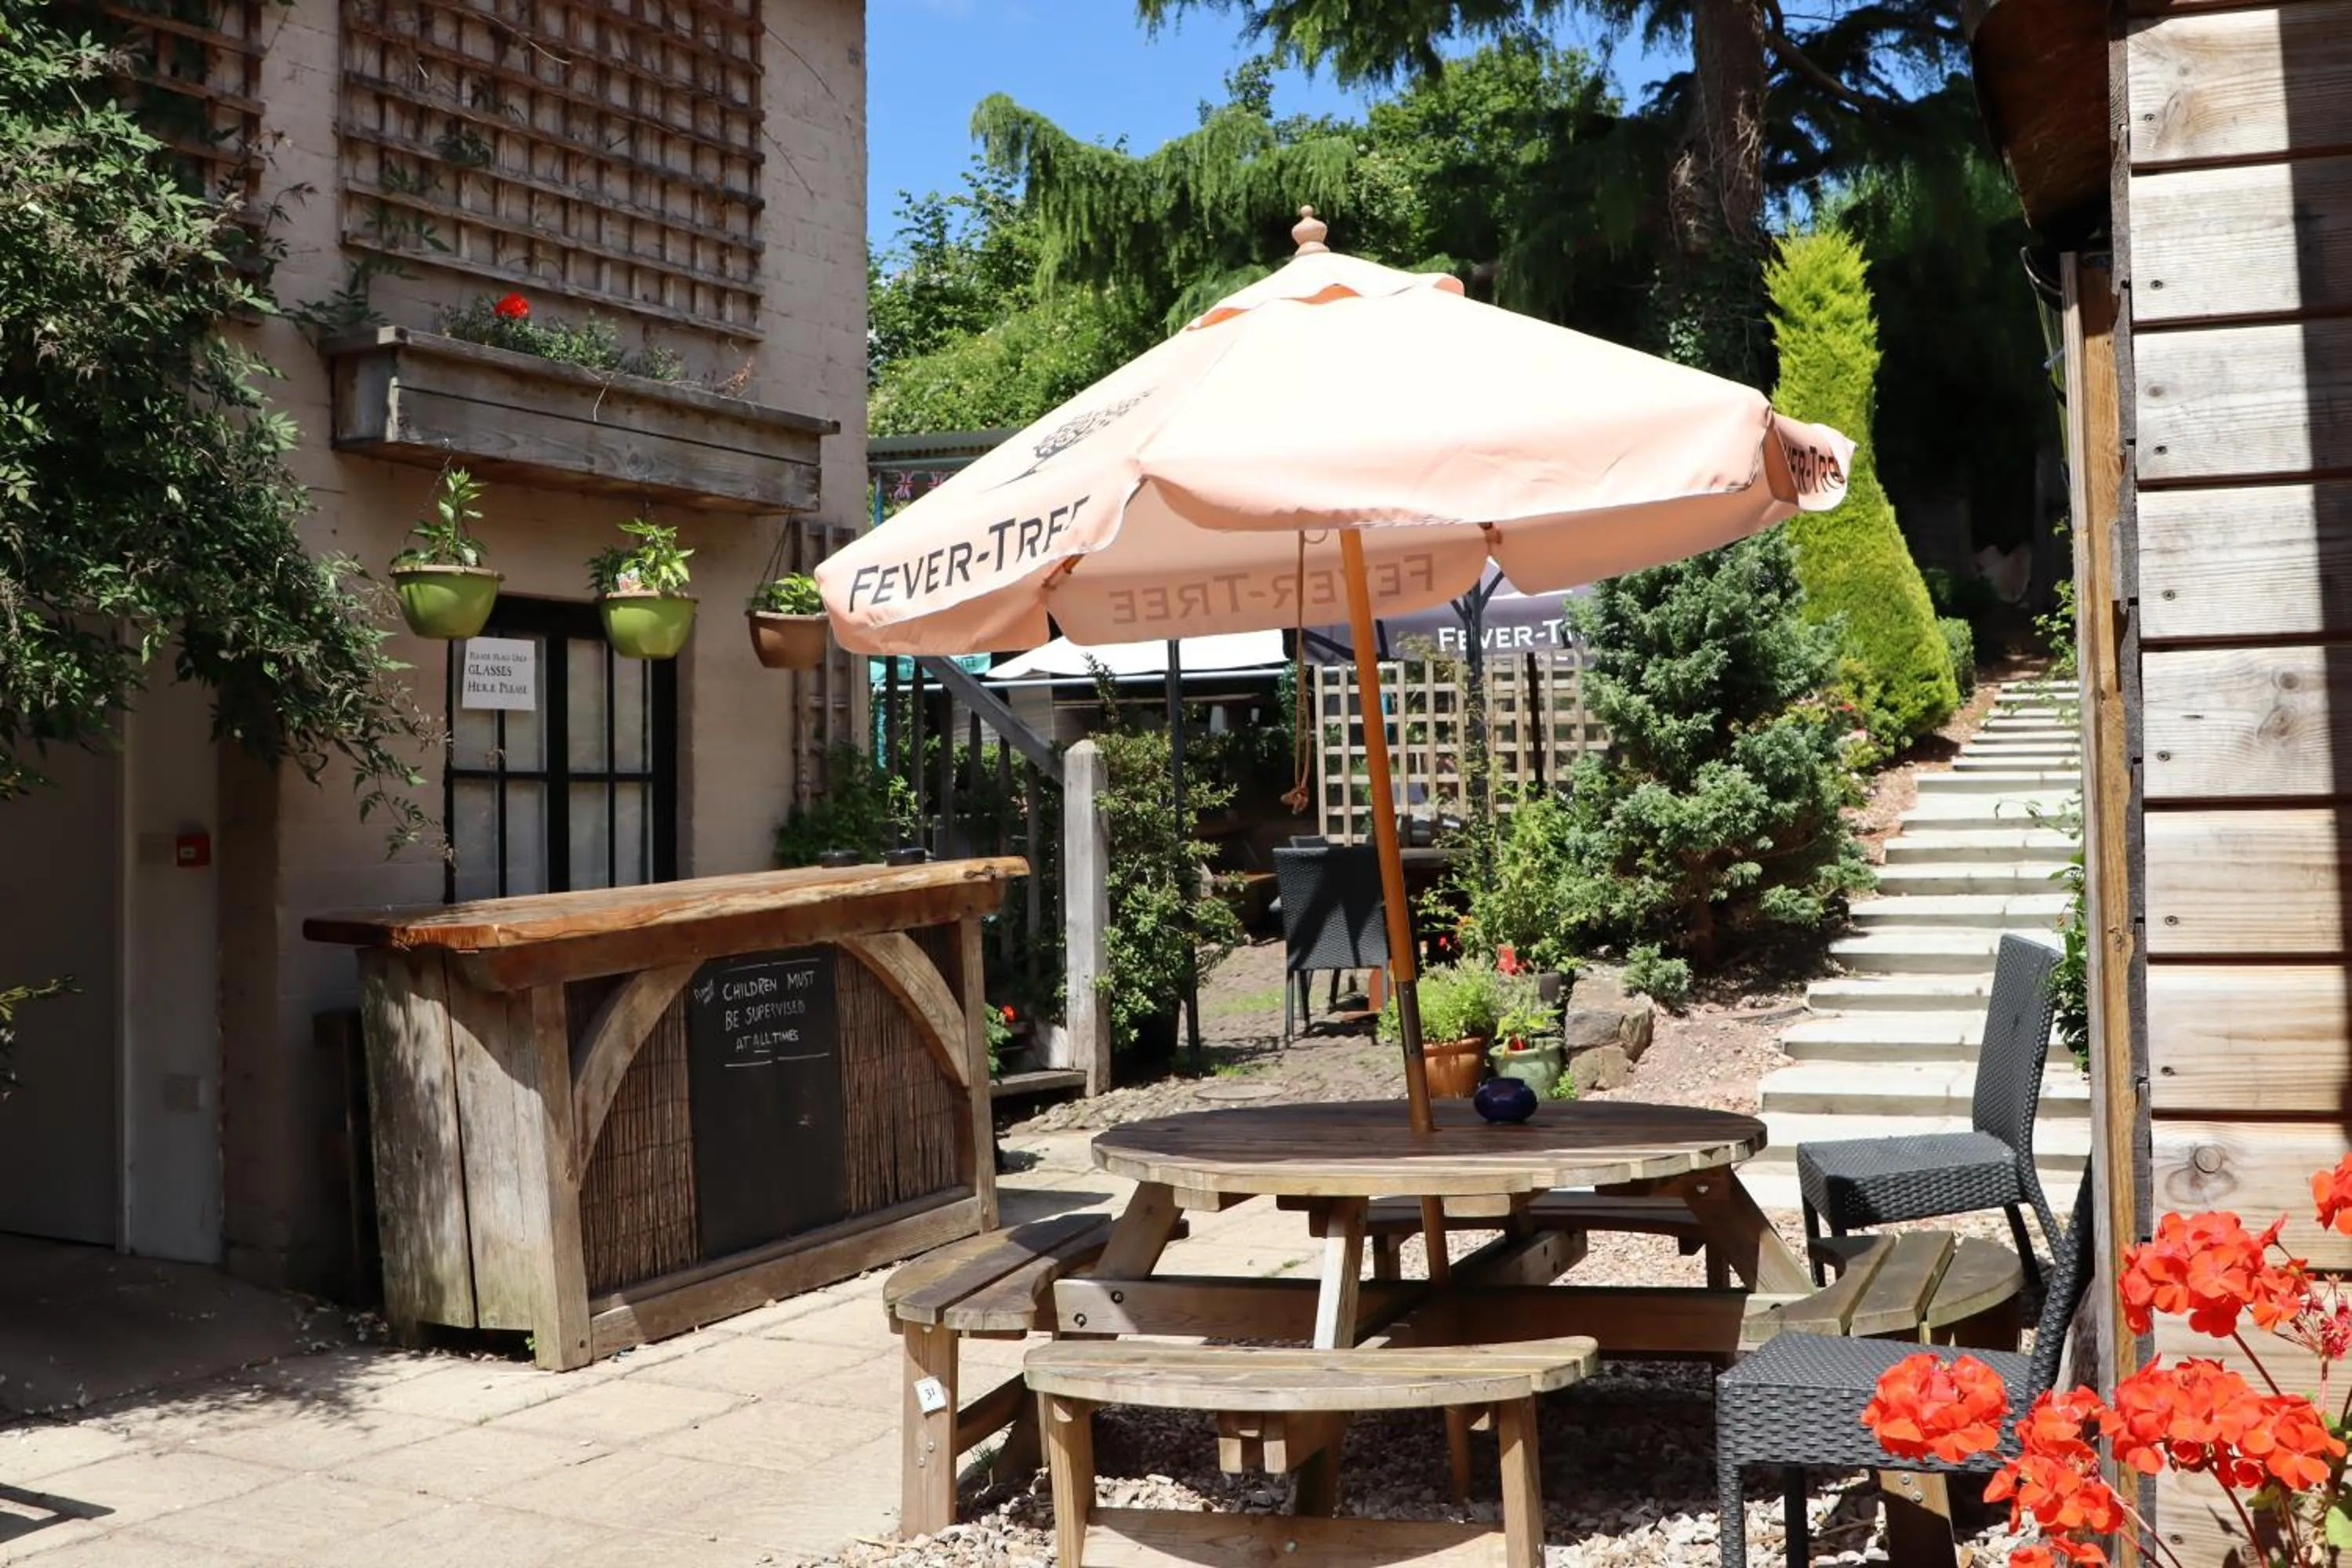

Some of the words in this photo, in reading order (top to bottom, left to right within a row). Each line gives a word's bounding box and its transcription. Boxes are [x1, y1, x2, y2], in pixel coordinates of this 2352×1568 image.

[468, 664, 512, 677] GLASSES
[723, 978, 777, 1001] CHILDREN
[787, 971, 815, 989] MUST
[725, 1010, 739, 1031] BE
[746, 1000, 806, 1025] SUPERVISED
[735, 1036, 752, 1052] AT
[753, 1032, 771, 1047] ALL
[771, 1029, 799, 1044] TIMES
